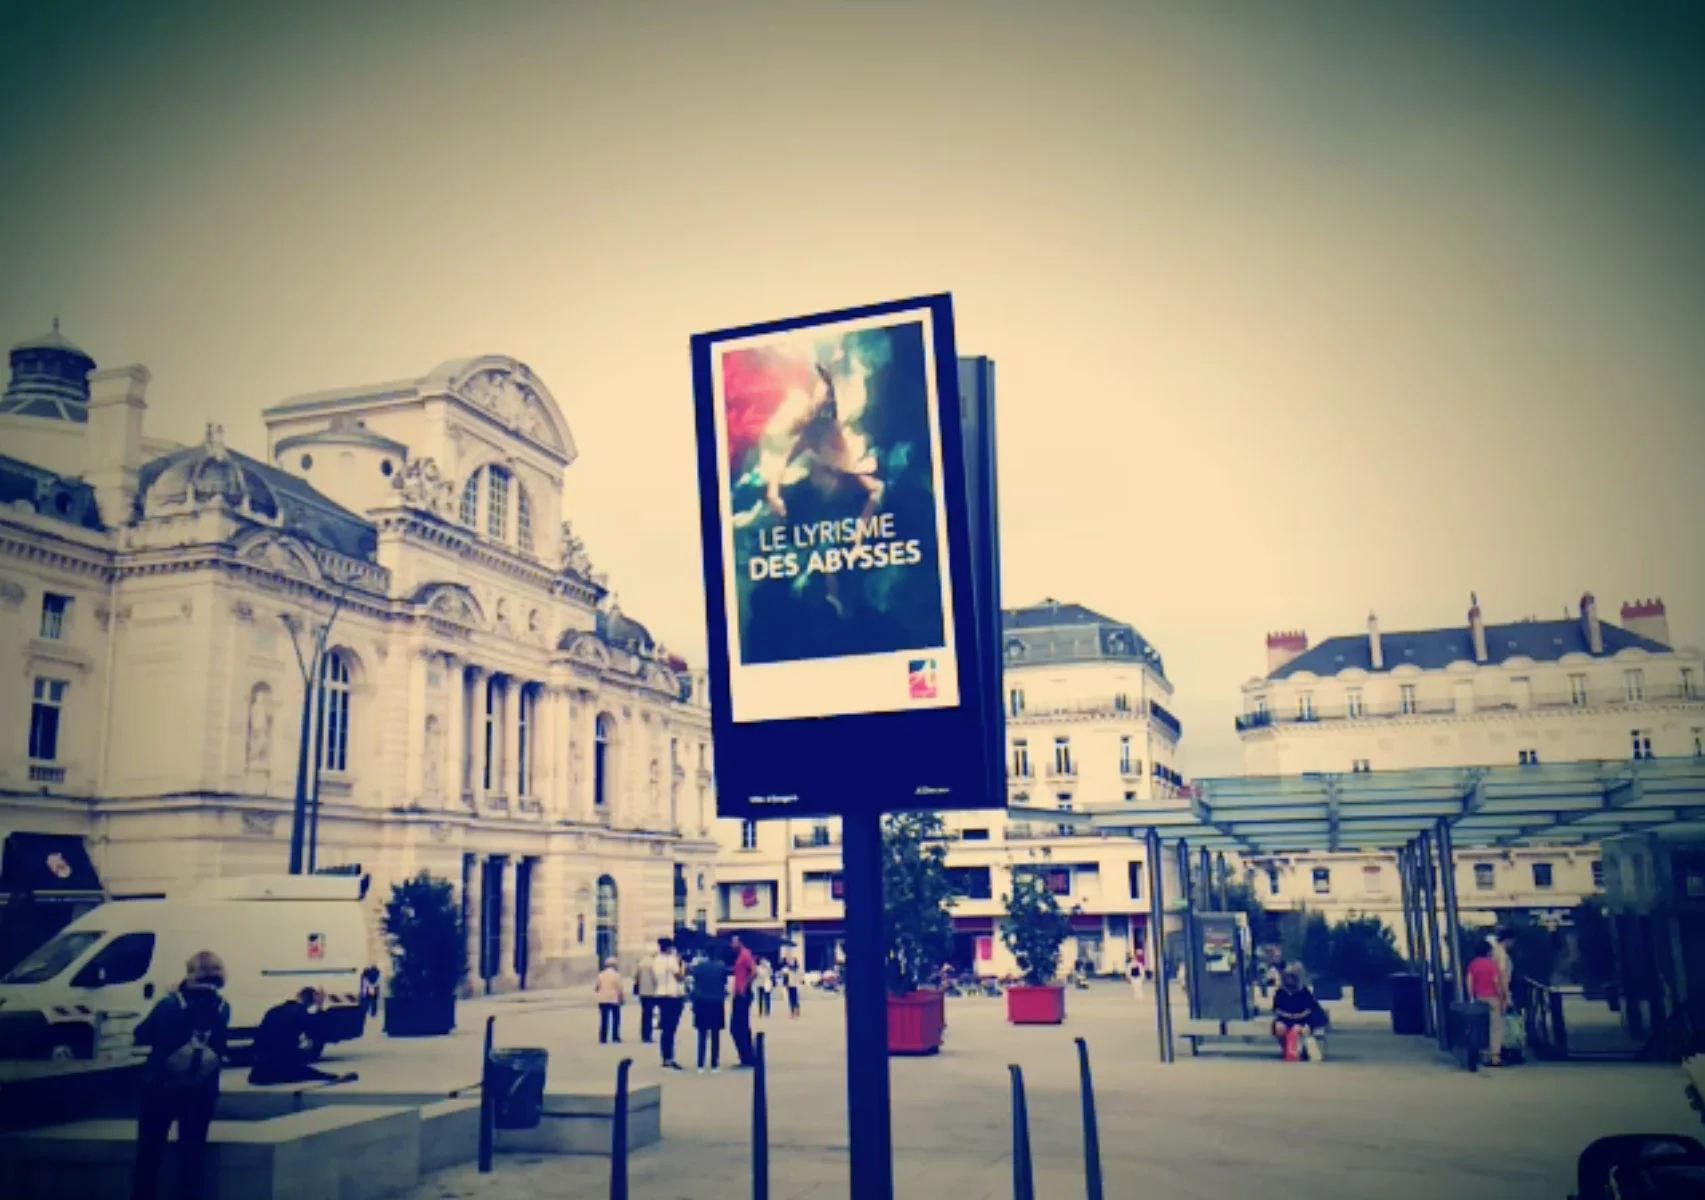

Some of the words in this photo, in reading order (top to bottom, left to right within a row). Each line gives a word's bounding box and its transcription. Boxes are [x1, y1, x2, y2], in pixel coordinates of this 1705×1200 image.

[759, 526, 787, 553] LE
[793, 513, 896, 548] LYRISME
[749, 553, 800, 581] DES
[807, 540, 921, 573] ABYSSES
